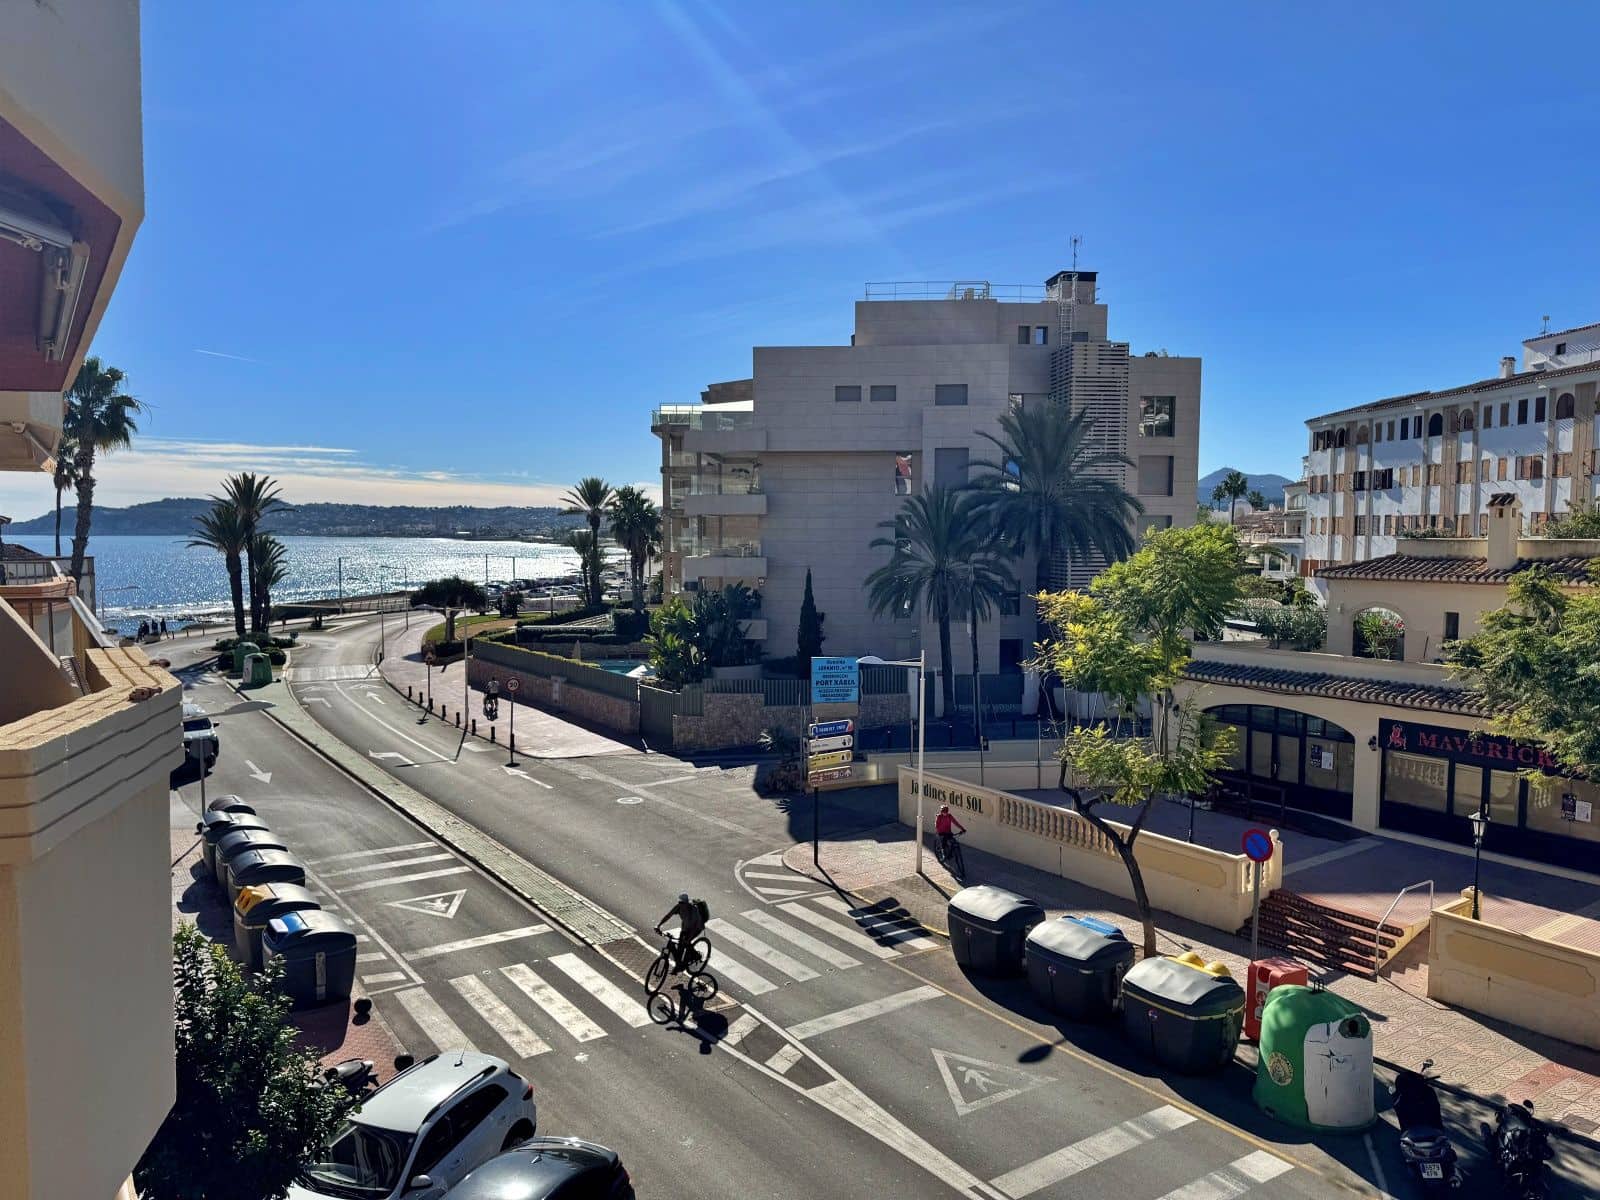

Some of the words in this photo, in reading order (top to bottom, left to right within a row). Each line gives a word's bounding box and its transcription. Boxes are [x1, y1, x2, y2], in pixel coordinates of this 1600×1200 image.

[1418, 731, 1555, 768] MAVERICK
[911, 779, 947, 802] Jadines
[949, 791, 963, 807] del
